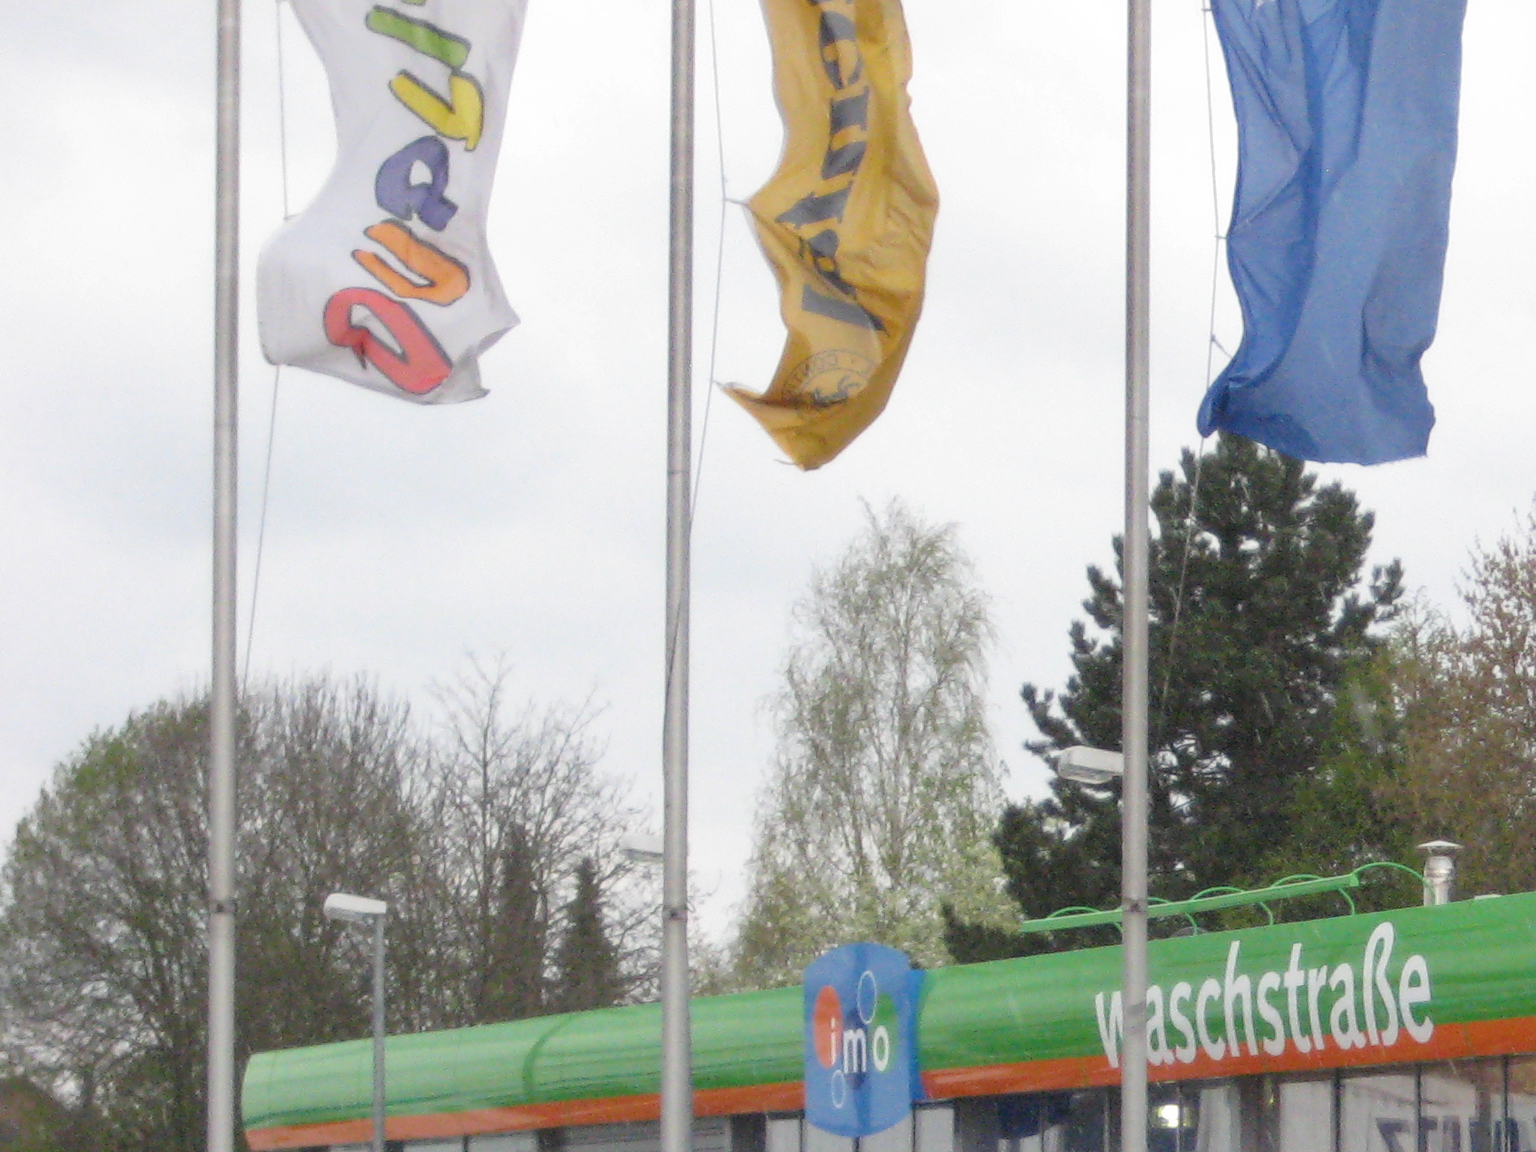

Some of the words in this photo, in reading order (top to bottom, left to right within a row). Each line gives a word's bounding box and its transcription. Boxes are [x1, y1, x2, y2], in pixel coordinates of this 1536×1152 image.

[323, 0, 484, 394] DUPLI
[831, 1017, 890, 1073] imo
[1095, 922, 1434, 1068] waschstraße
